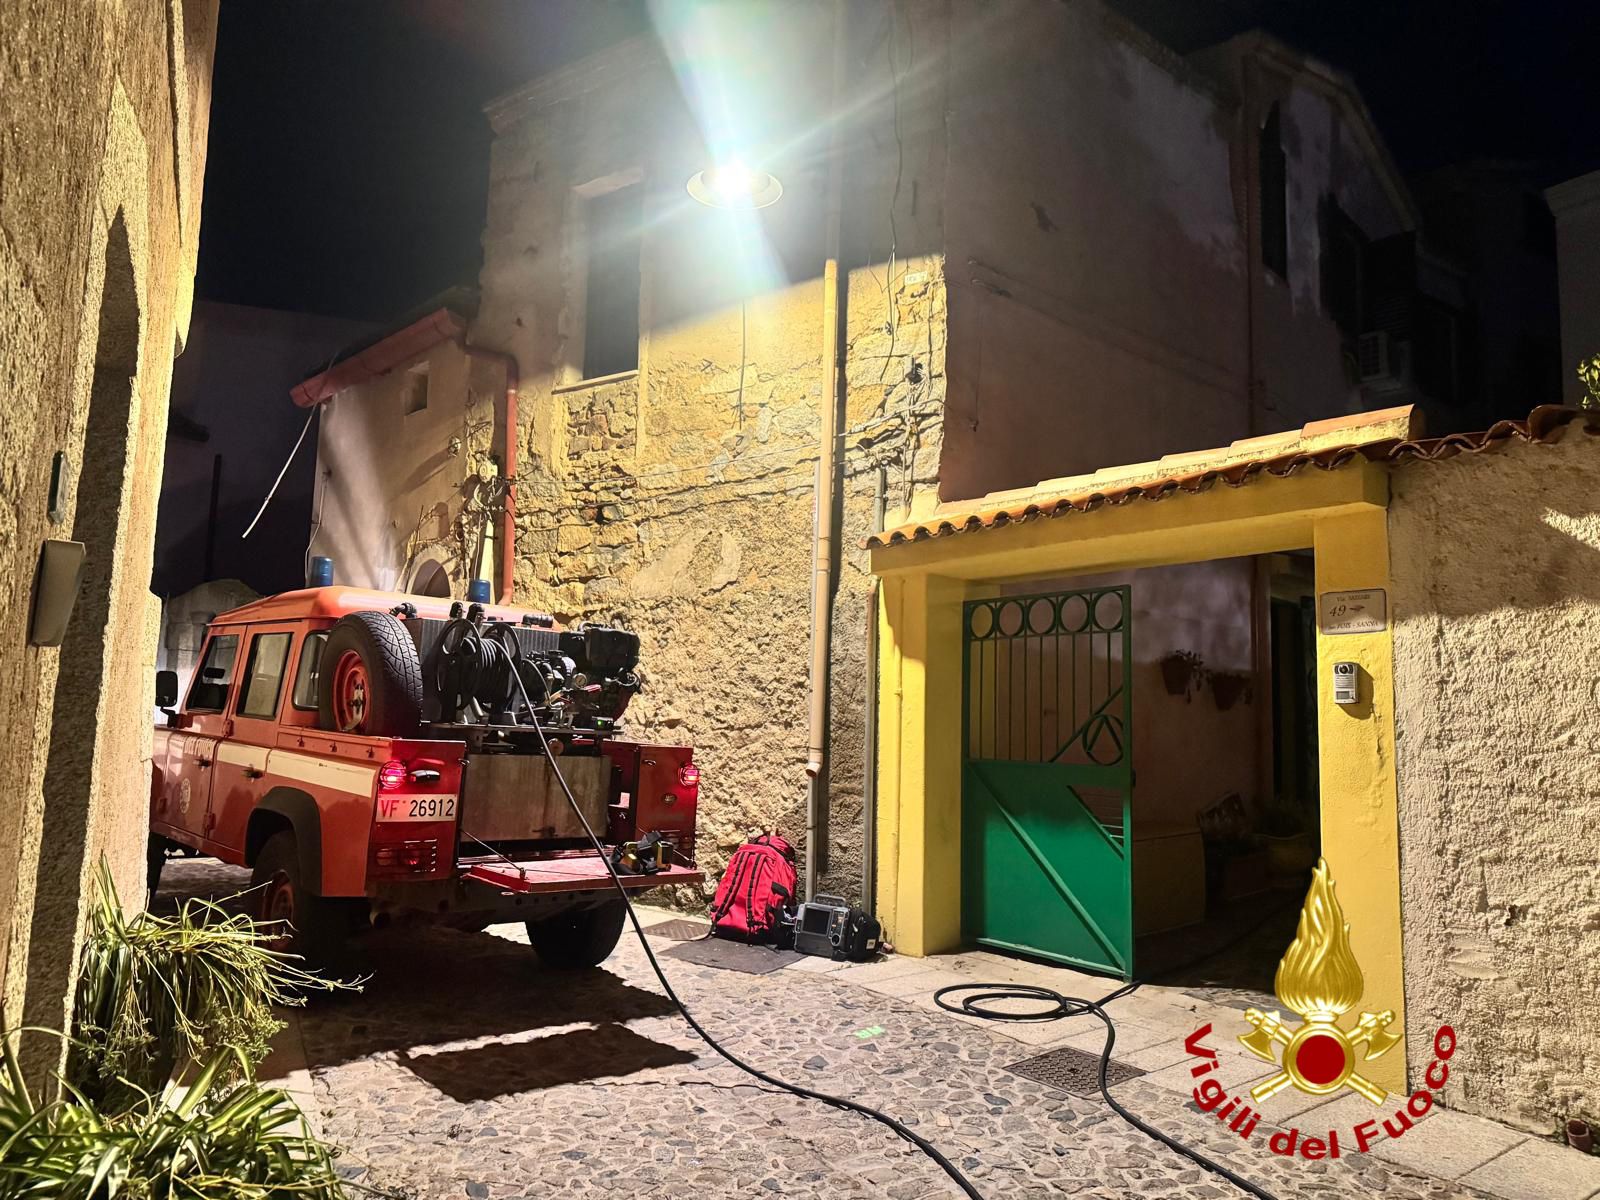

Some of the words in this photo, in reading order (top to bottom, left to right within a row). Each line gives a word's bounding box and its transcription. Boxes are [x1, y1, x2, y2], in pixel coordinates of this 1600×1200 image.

[1329, 604, 1346, 617] 49
[380, 799, 399, 818] VF
[409, 798, 455, 818] 26912
